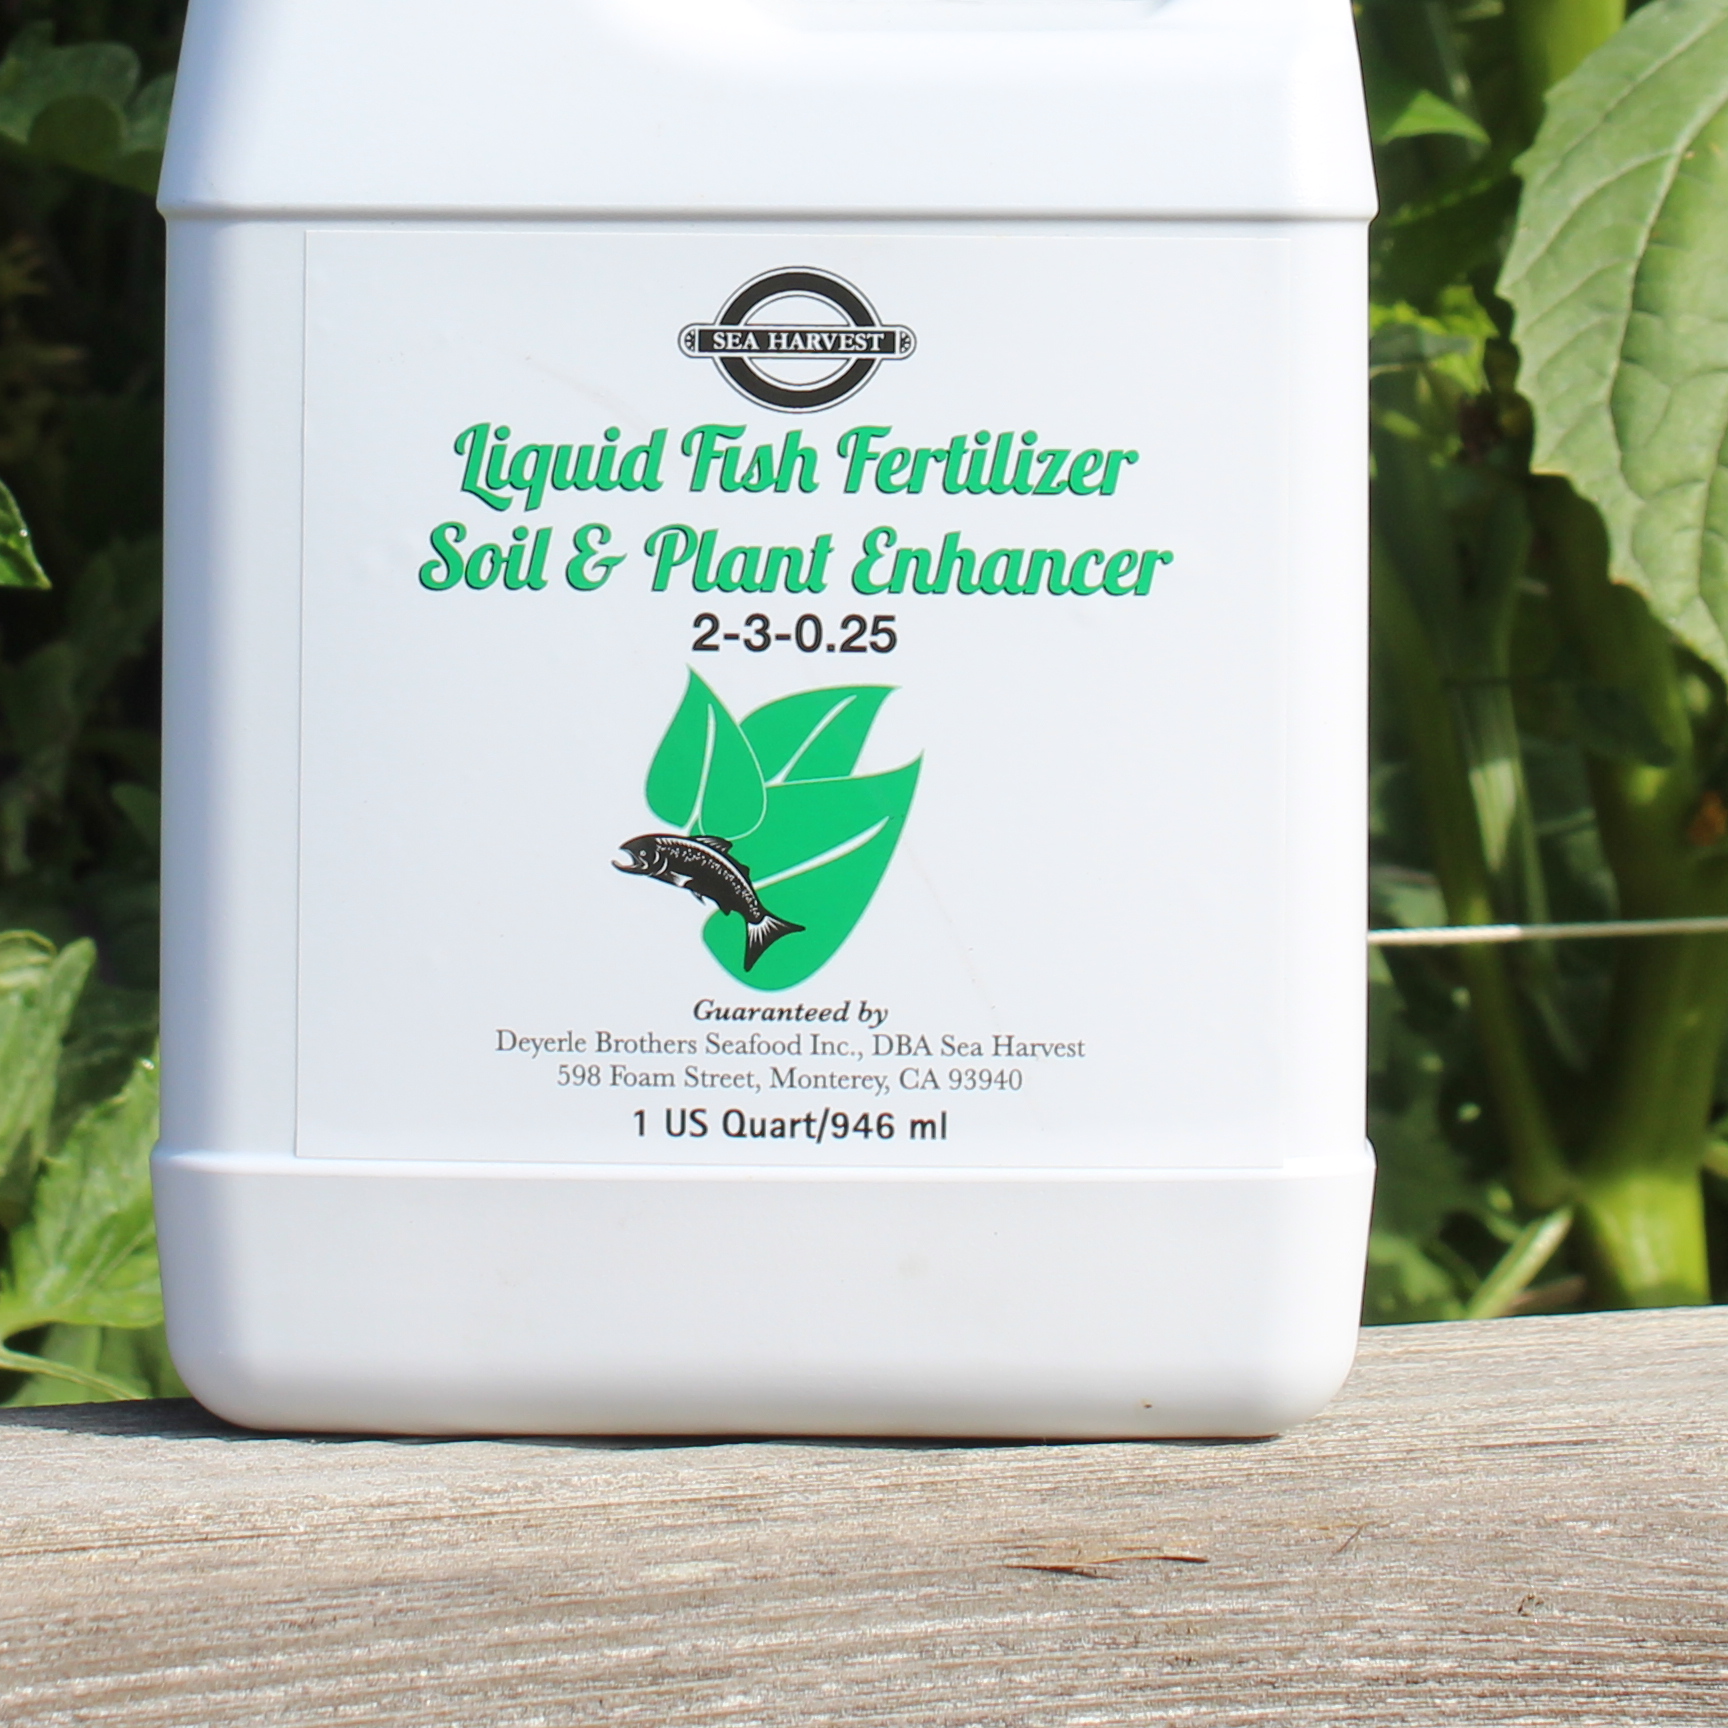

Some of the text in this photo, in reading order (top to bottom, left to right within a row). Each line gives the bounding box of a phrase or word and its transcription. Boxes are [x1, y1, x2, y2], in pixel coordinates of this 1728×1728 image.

[711, 331, 885, 352] SEA HARVEST
[454, 423, 1139, 512] Liquid Fish Fertilizer
[418, 522, 1174, 596] Soil & Plant Enhancer
[692, 612, 897, 654] 2-3-0.25
[694, 999, 888, 1029] Guaranteed by
[496, 1030, 1084, 1061] Deyerle Brothers Seafood Inc., DBA Sea Harvest
[558, 1064, 1022, 1096] 598 Foam Street, Monterey, CA 93940
[634, 1108, 946, 1144] 1 US Quart/946 ml
